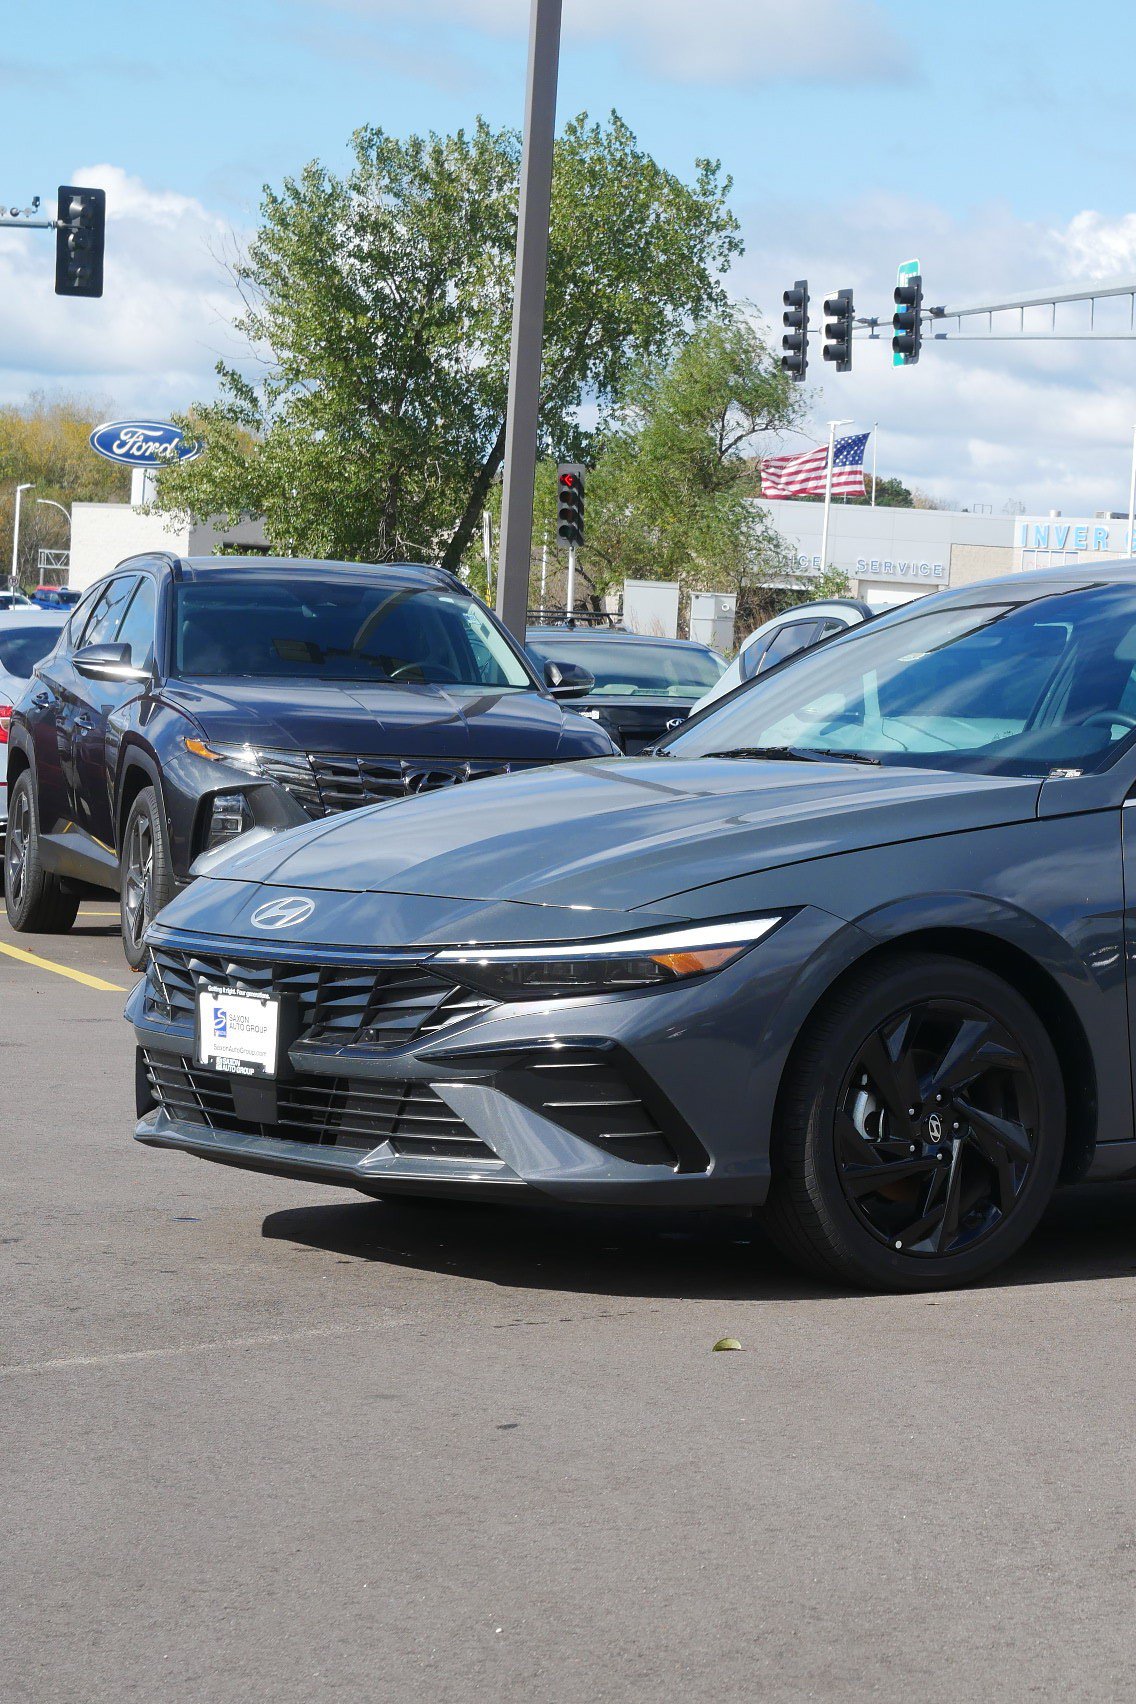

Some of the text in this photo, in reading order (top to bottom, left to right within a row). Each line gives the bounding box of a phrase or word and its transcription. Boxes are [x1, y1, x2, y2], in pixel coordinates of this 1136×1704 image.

[113, 427, 179, 457] Ford
[1020, 522, 1109, 551] INVER
[857, 558, 942, 577] SERVICE
[229, 1013, 250, 1023] SAXON
[229, 1022, 267, 1034] AUTO GROUP
[213, 1043, 267, 1057] SaxonAutoGroup.com
[222, 1058, 240, 1066] SAXON
[236, 1066, 254, 1075] GROUP
